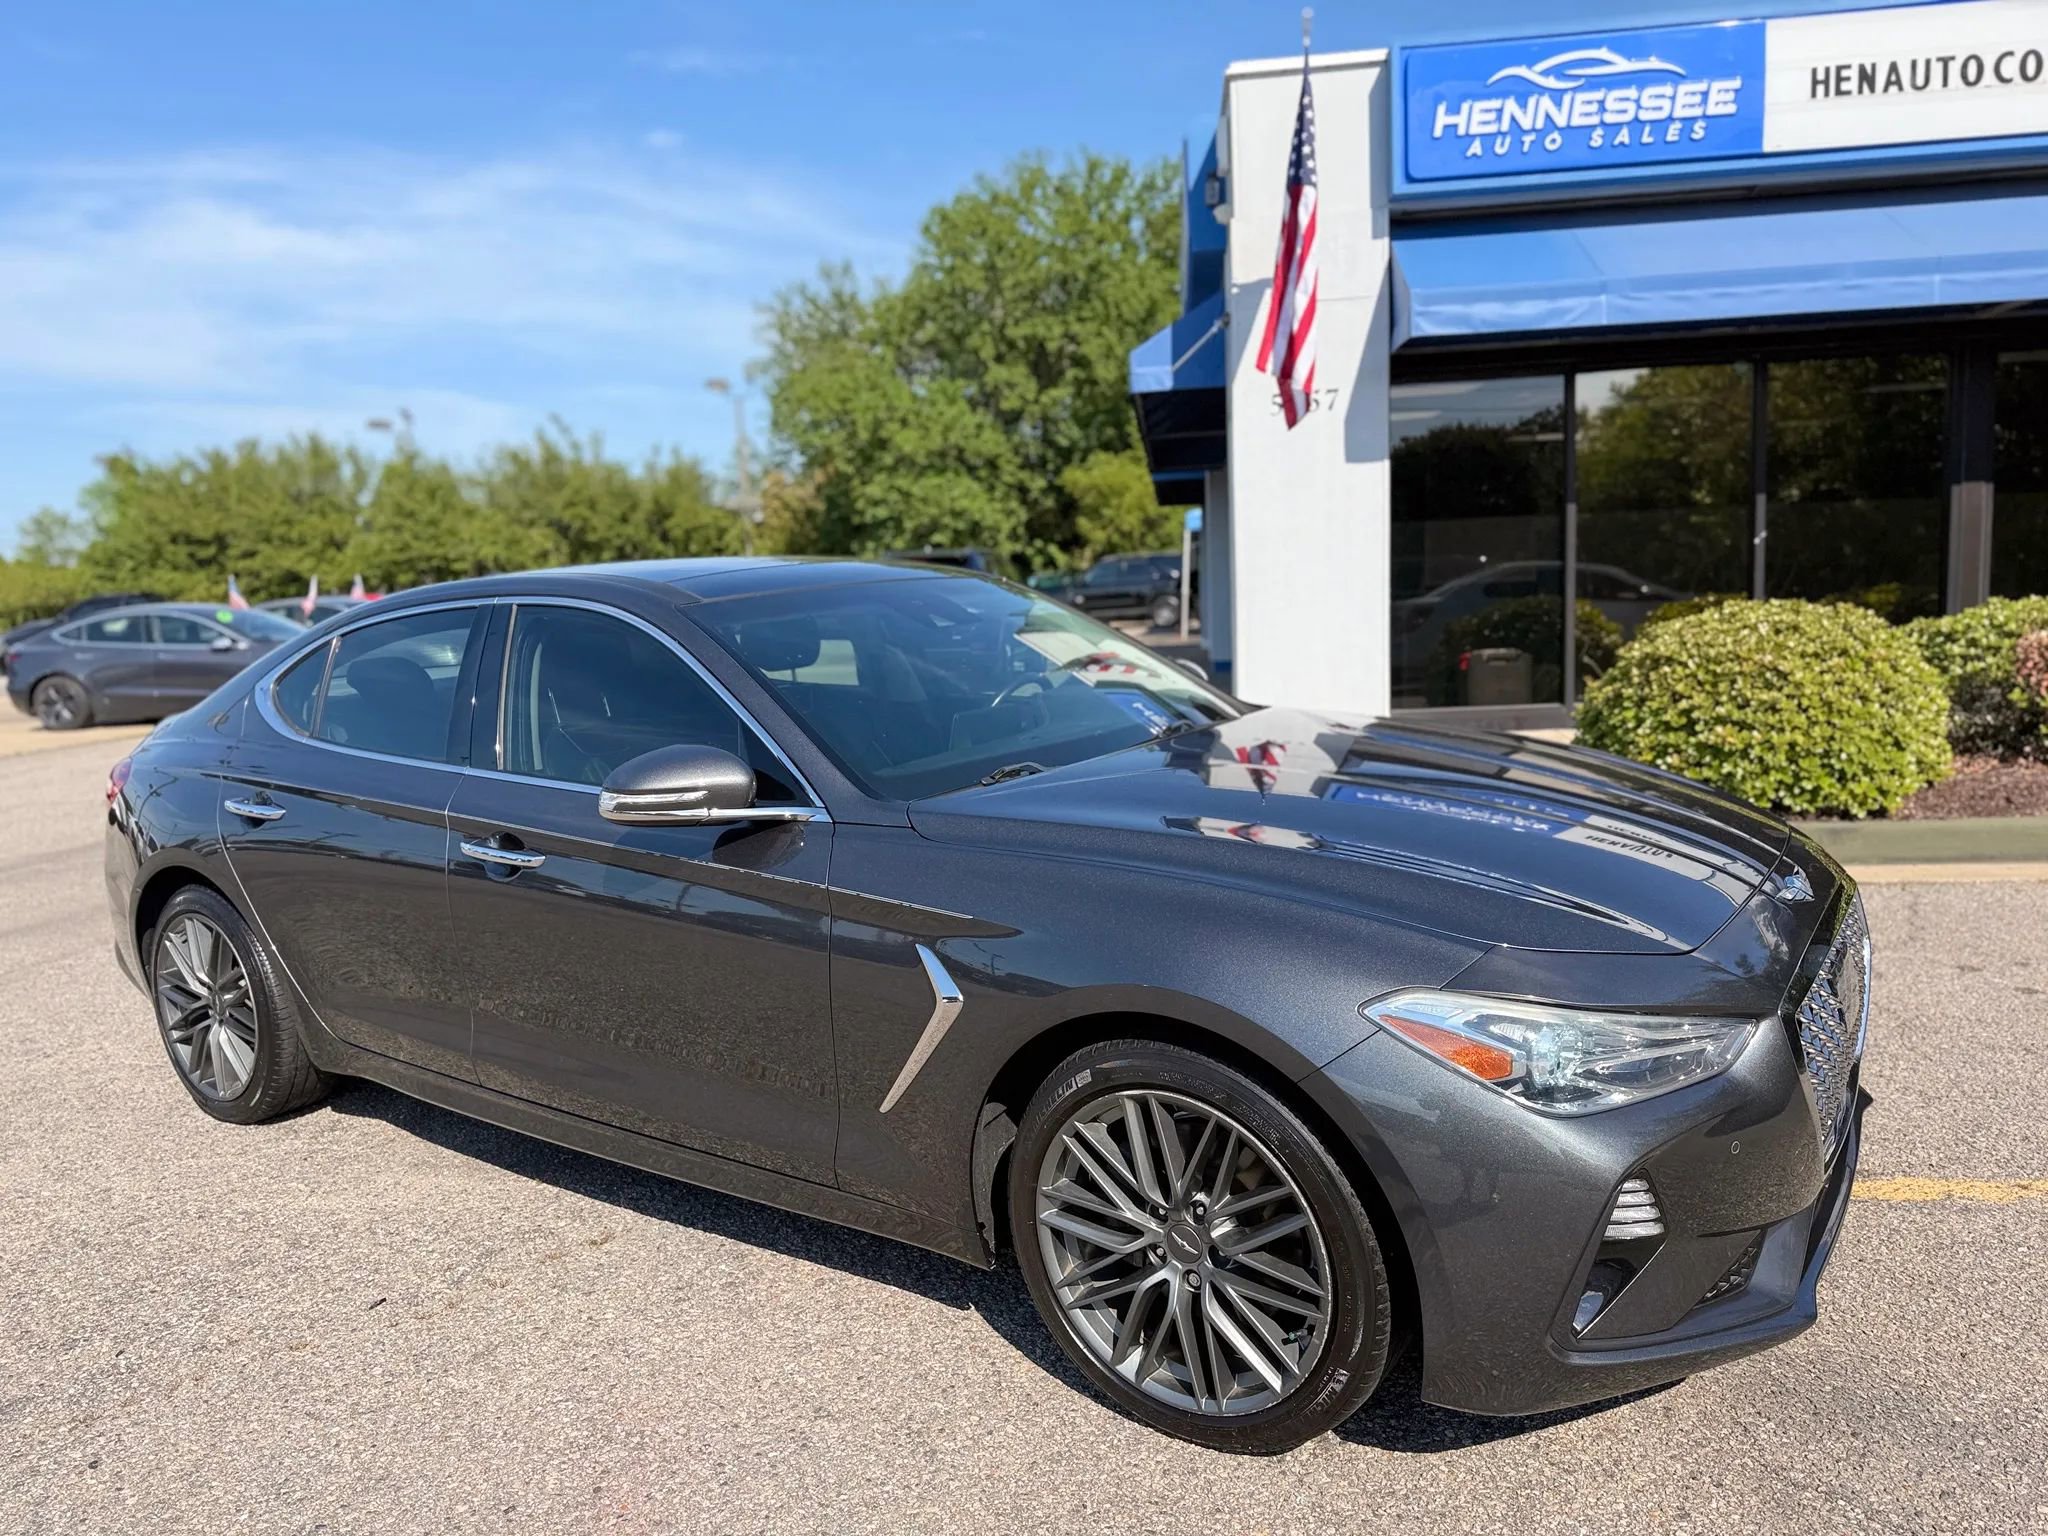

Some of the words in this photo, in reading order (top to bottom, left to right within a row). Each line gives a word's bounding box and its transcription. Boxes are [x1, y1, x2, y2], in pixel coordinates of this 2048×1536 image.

[1433, 77, 1742, 138] HENNESSEE
[1465, 132, 1562, 157] AUTO
[1589, 121, 1706, 147] SALES
